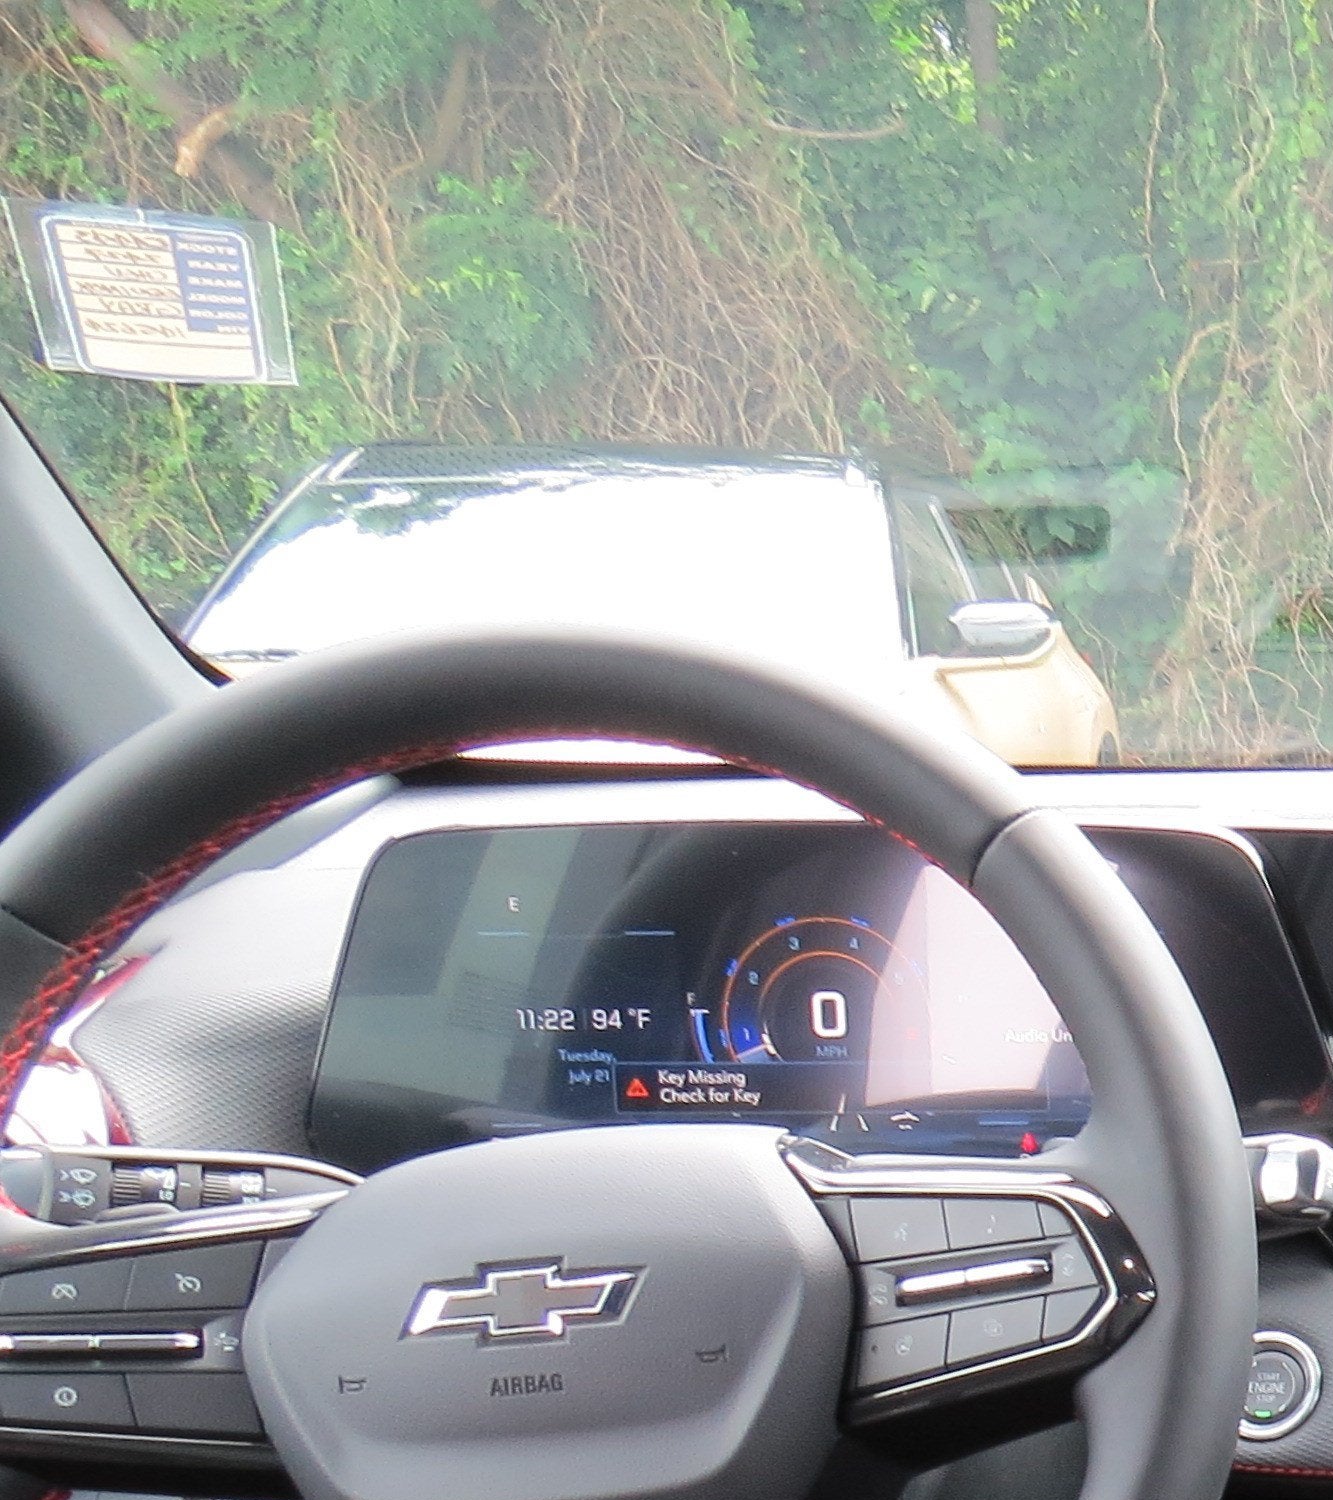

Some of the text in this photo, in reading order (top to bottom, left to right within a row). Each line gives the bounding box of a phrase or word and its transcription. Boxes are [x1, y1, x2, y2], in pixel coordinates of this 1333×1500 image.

[515, 1008, 576, 1031] 11:22
[592, 1008, 623, 1031] 94
[810, 990, 848, 1038] 0
[569, 1069, 592, 1086] July
[657, 1069, 747, 1088] Key Missing
[660, 1089, 761, 1106] Check for Key
[490, 1373, 563, 1396] AIRBAG
